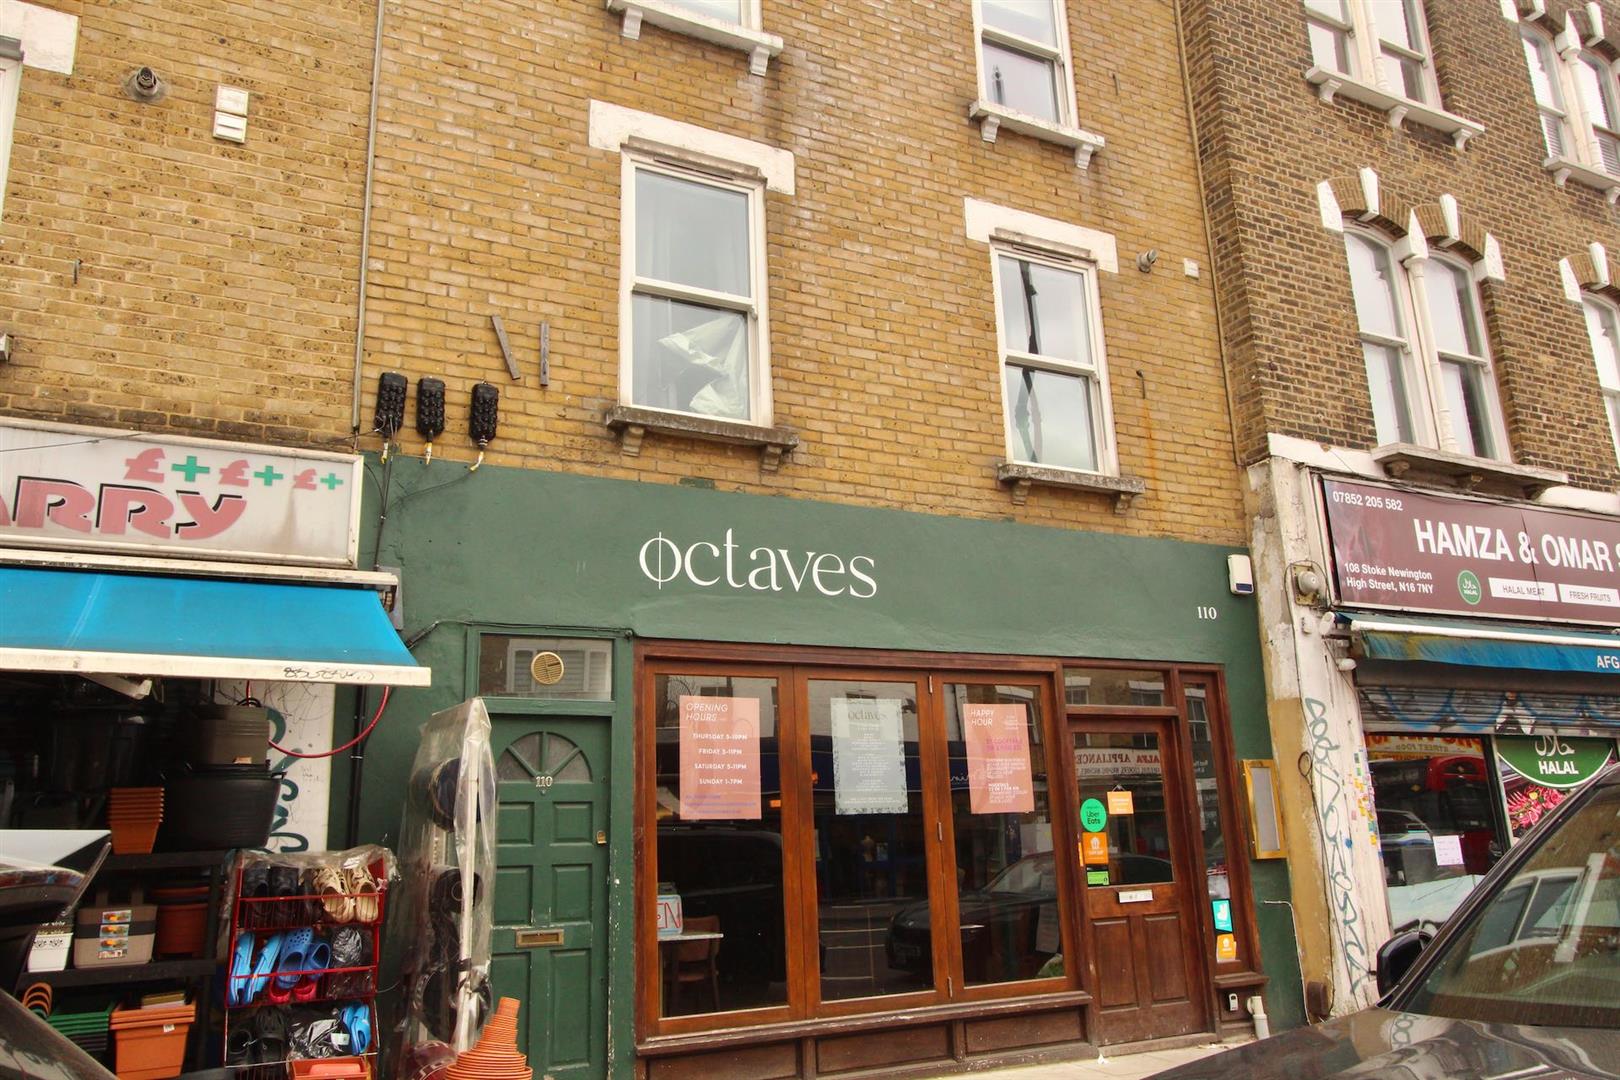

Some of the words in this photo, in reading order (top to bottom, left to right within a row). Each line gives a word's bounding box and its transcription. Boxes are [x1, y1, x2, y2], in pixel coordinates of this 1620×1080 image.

[1332, 490, 1364, 506] 07852
[1365, 495, 1383, 508] 205
[1385, 498, 1403, 511] 582
[0, 475, 247, 541] RRY
[1413, 518, 1514, 562] HAMZA
[1518, 531, 1537, 564] &
[1541, 533, 1615, 572] OMAR
[1344, 562, 1360, 573] 108
[1361, 563, 1387, 576] Stoke
[1387, 565, 1433, 581] Newington
[1346, 576, 1367, 590] High
[1368, 579, 1398, 592] Street,
[1399, 581, 1416, 593] N16
[1417, 583, 1434, 594] 7NY
[1502, 585, 1526, 595] HALAL
[1526, 587, 1545, 596] MEAT
[1569, 590, 1589, 600] FRESH
[1590, 592, 1612, 602] FRUITS
[1197, 606, 1217, 620] 110
[685, 702, 729, 712] OPENING
[970, 708, 995, 717] HAPPY
[684, 712, 718, 721] HOURS
[971, 717, 993, 727] HOUR
[692, 732, 724, 740] THURSDAY
[698, 747, 721, 755] FRIDAY
[1538, 760, 1579, 775] HALAL
[535, 776, 553, 788] 110
